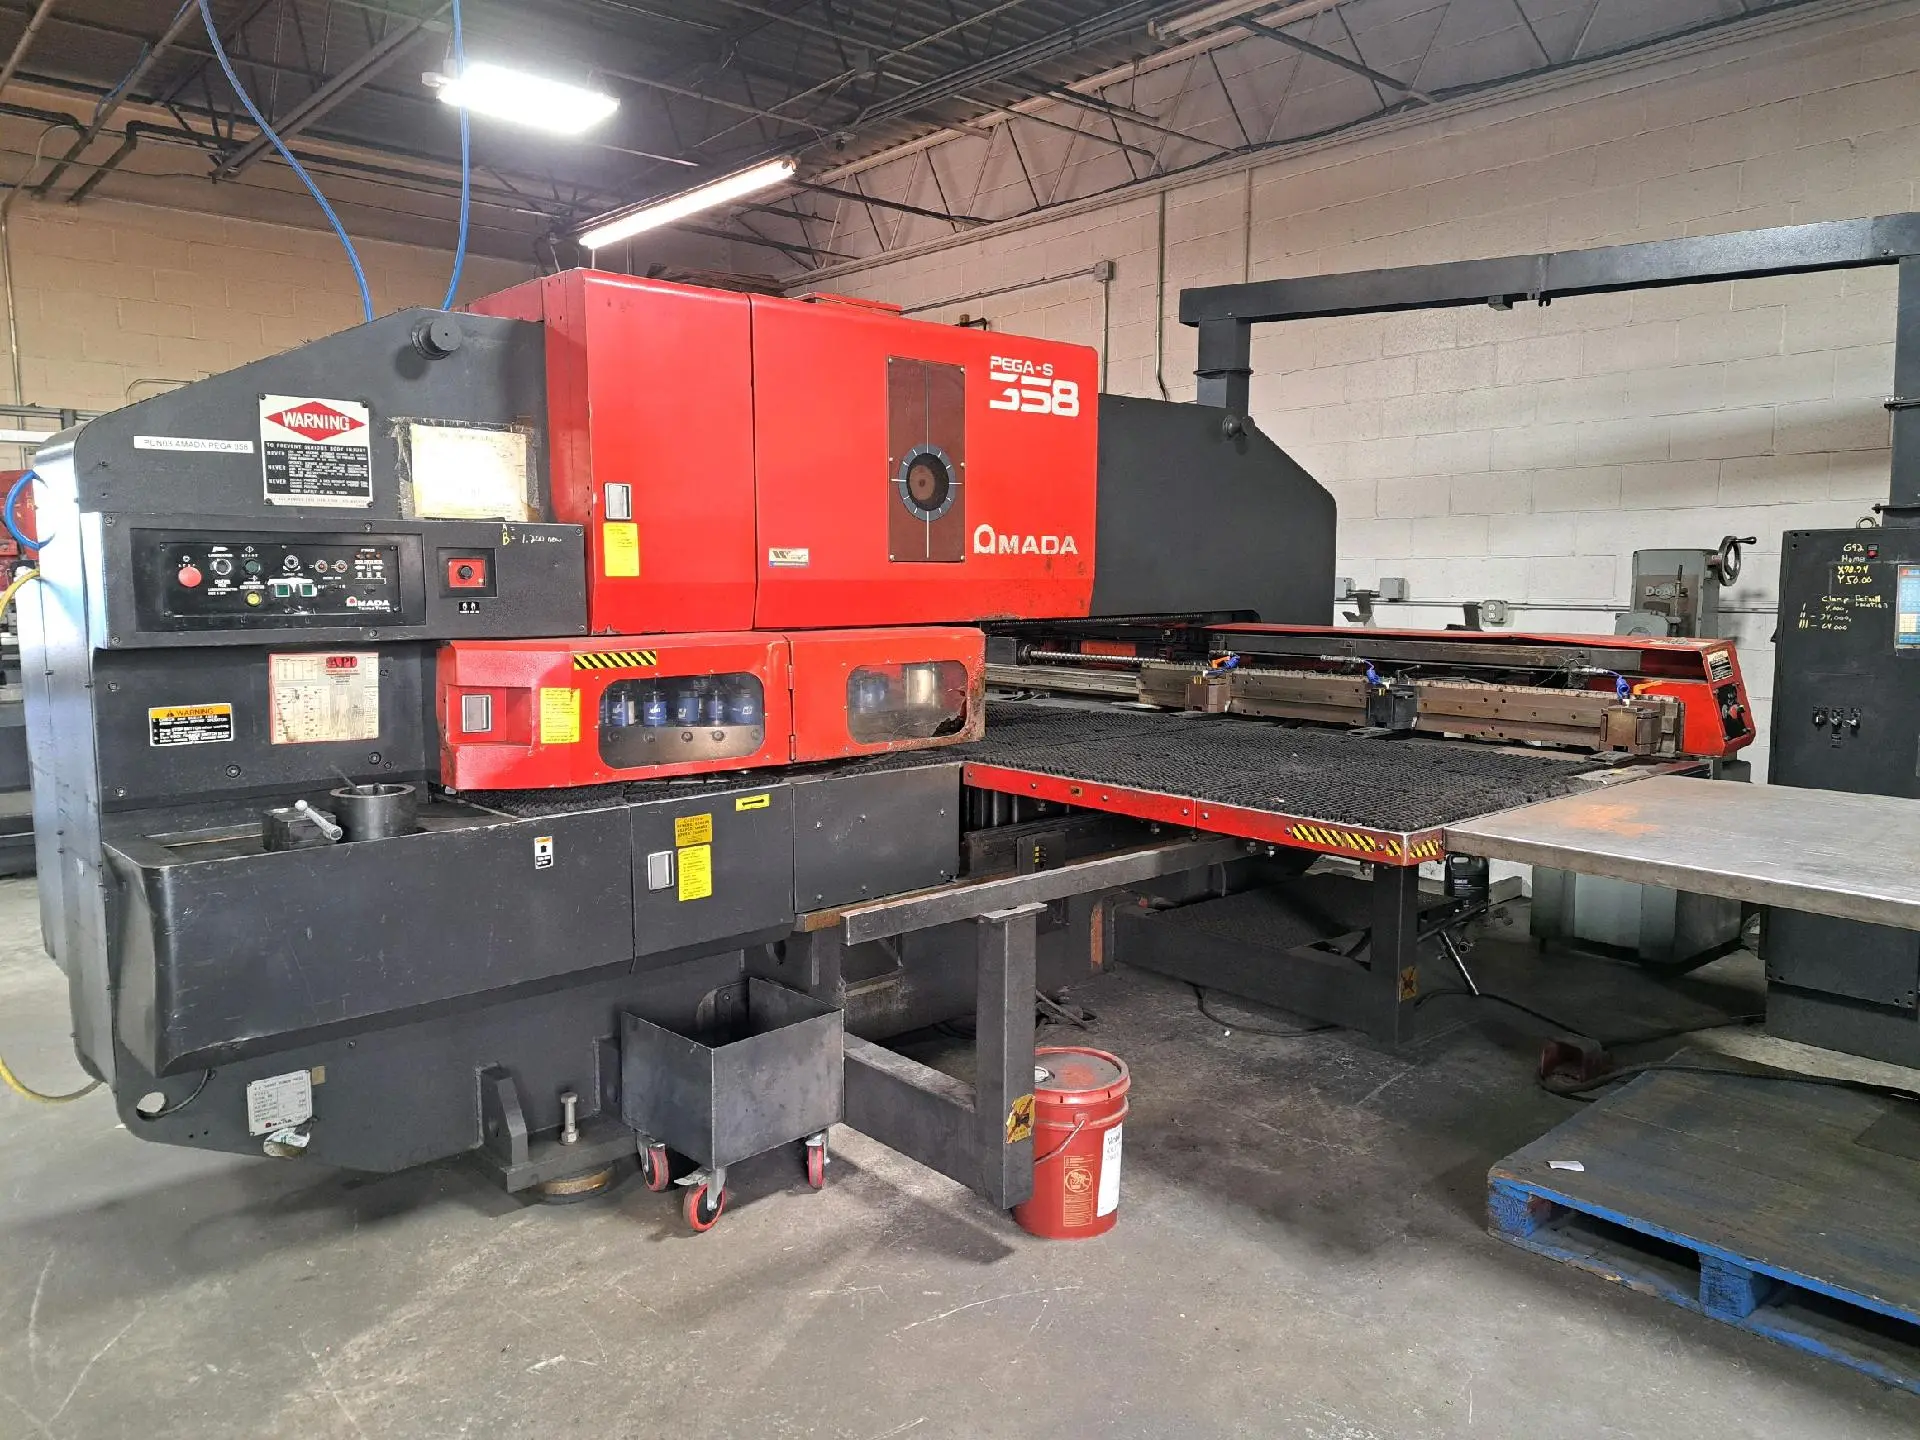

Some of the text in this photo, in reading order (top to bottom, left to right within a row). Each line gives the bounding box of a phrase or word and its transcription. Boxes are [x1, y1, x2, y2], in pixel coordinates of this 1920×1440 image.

[990, 356, 1053, 377] PEGA-S
[989, 371, 1079, 418] 358
[281, 411, 350, 431] WARNING
[502, 532, 510, 545] B
[973, 523, 1078, 555] AMADA
[1843, 543, 1865, 552] G92
[1821, 595, 1850, 604] Clamp
[176, 708, 214, 716] WARNING
